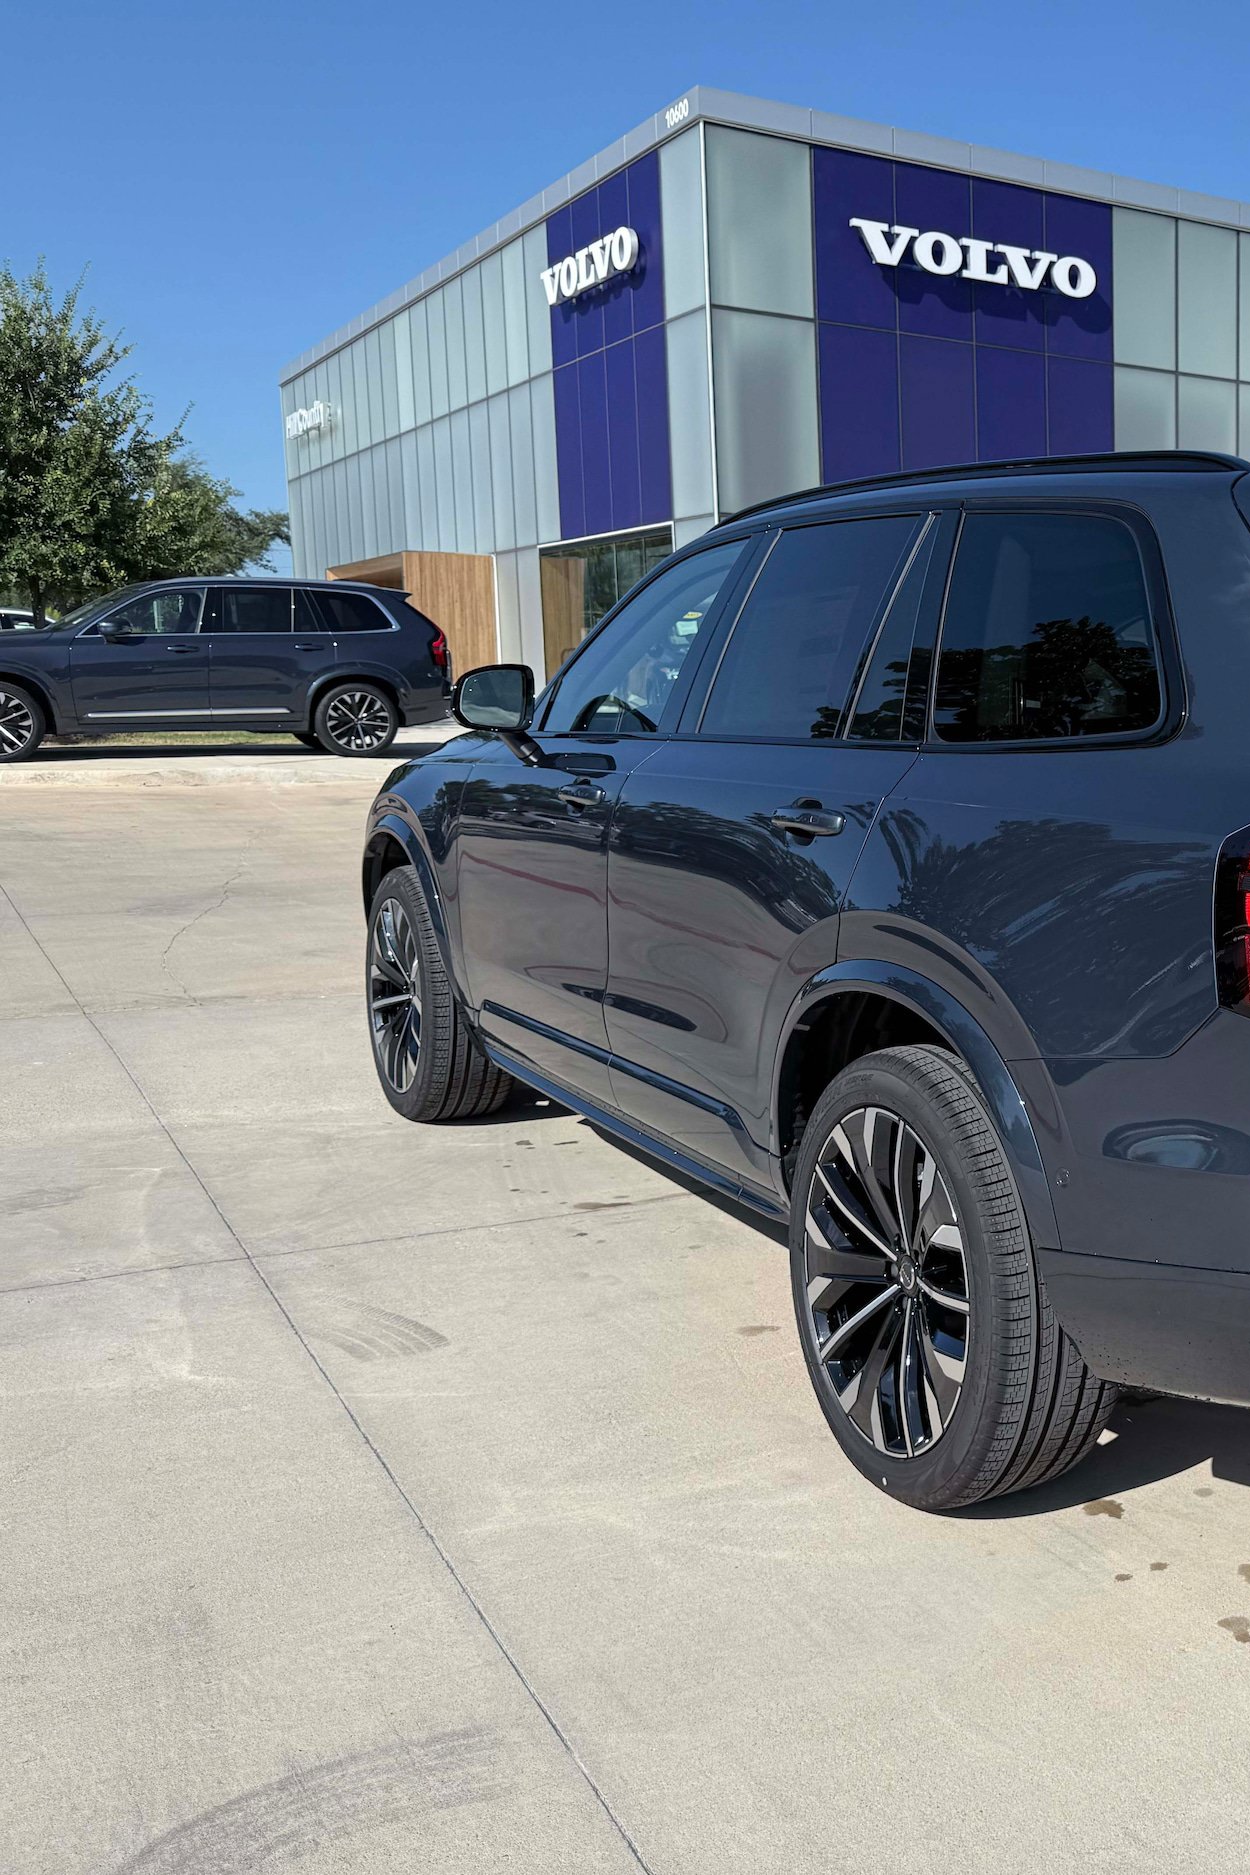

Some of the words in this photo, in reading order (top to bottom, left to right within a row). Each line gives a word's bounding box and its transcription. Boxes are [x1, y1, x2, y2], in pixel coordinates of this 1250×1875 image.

[665, 98, 689, 129] 10600
[540, 226, 638, 306] VOLVO
[849, 217, 1097, 299] VOLVO
